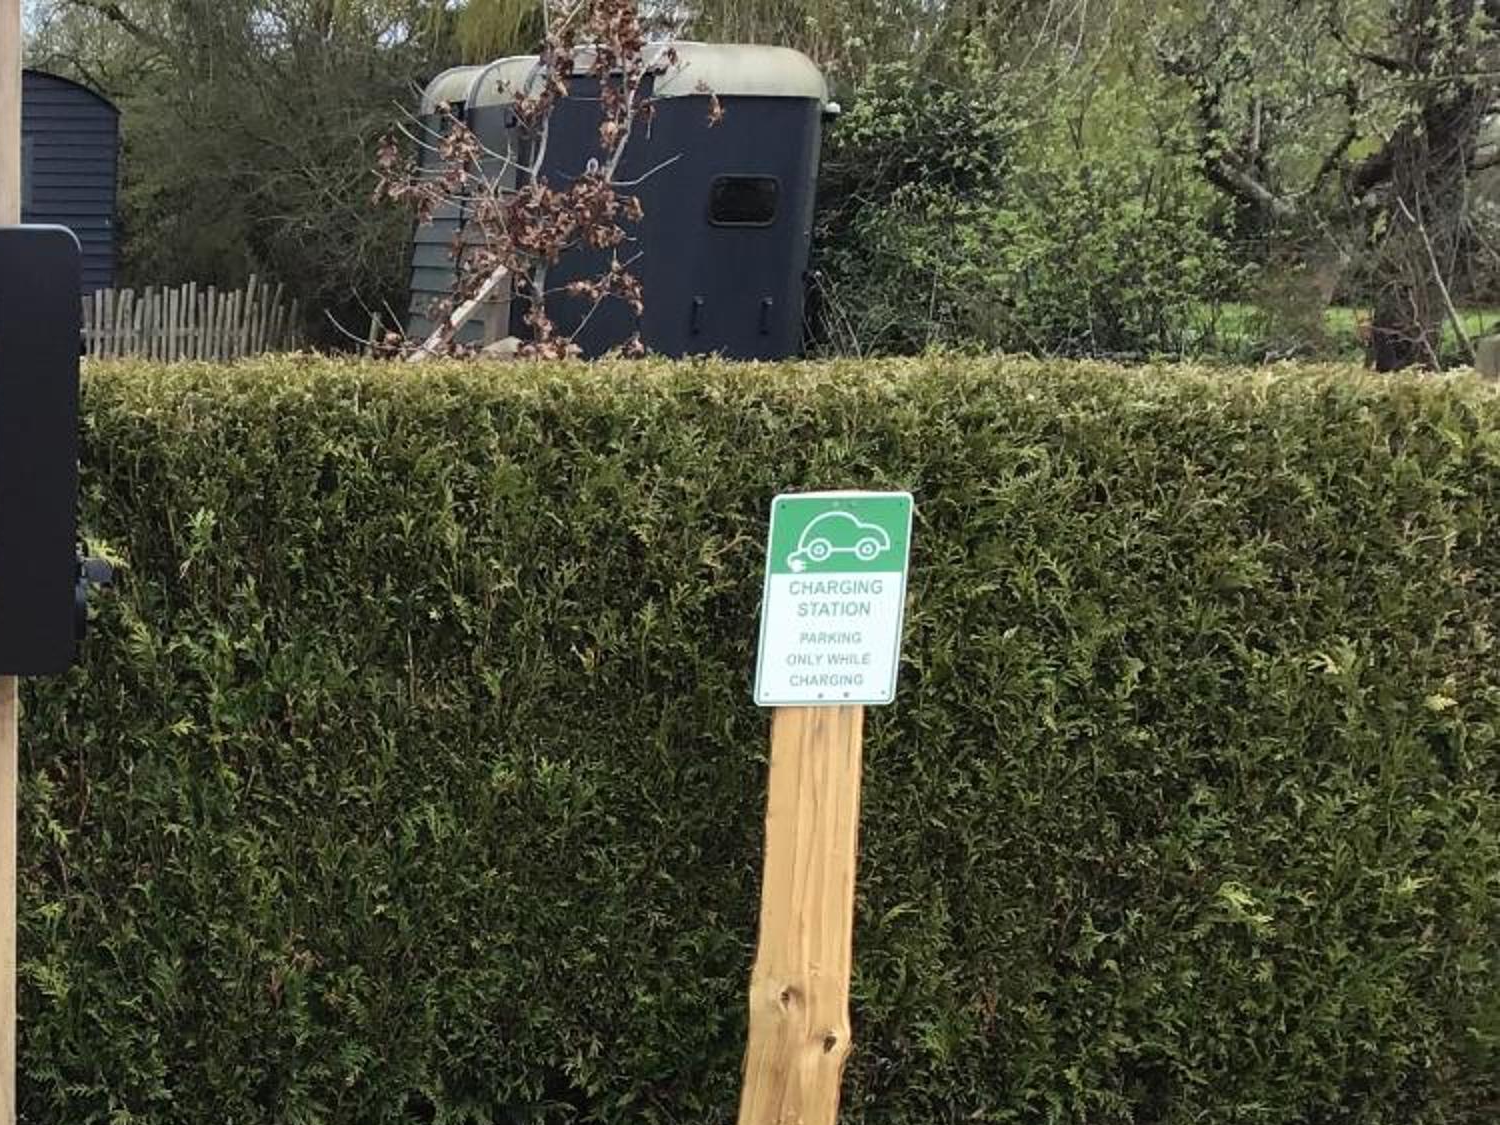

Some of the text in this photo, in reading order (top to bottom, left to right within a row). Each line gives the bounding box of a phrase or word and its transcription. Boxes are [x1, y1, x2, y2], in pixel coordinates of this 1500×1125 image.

[788, 579, 883, 596] CHARGING
[796, 601, 871, 617] STATION
[799, 631, 862, 645] PARKING
[785, 652, 872, 667] ONLY WHILE
[789, 673, 864, 687] CHARGING
